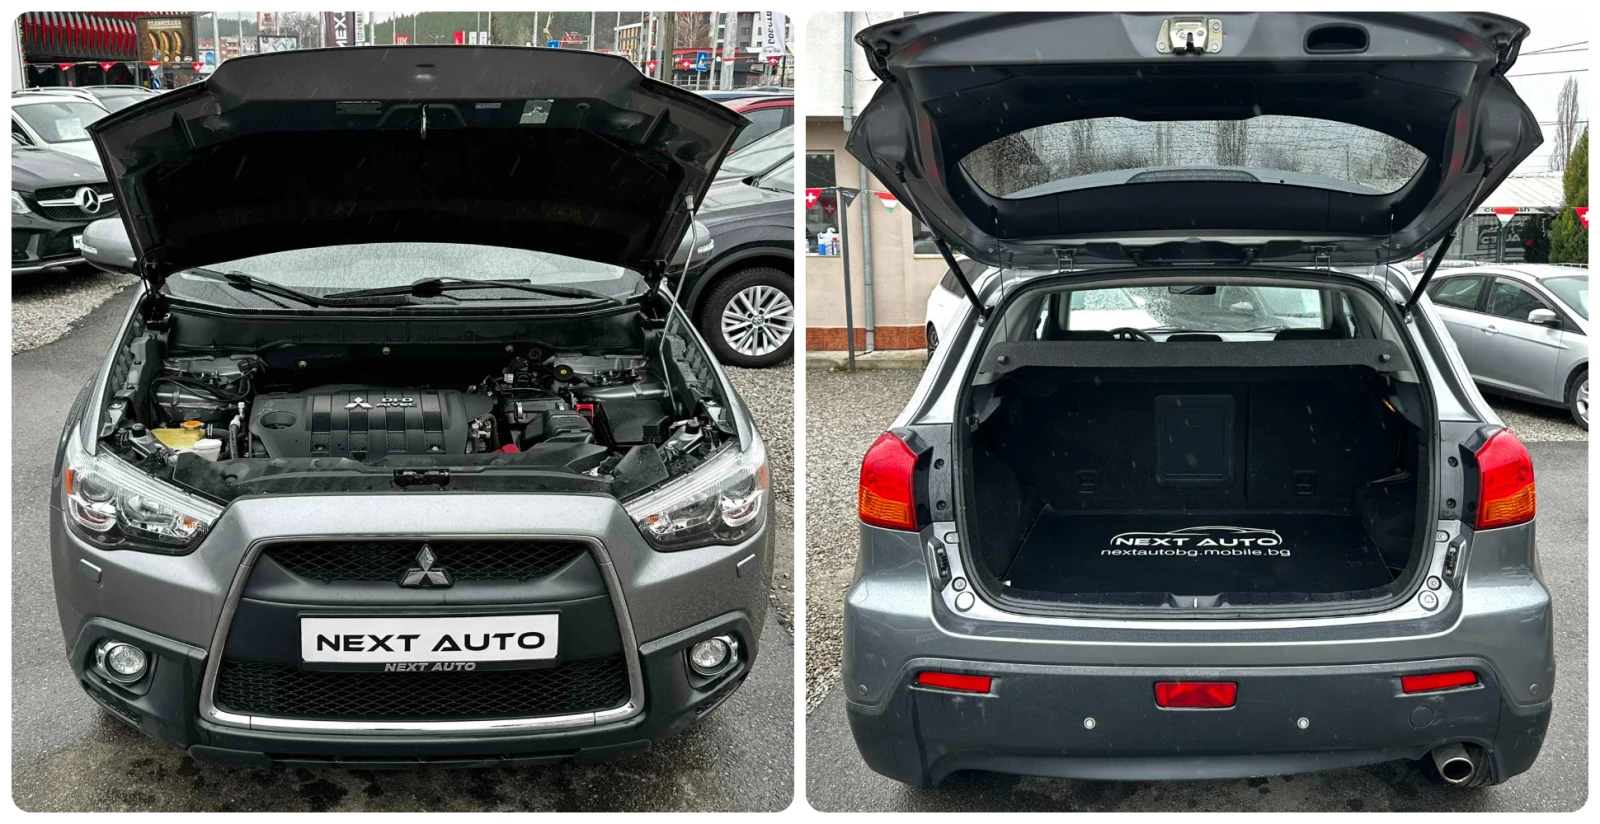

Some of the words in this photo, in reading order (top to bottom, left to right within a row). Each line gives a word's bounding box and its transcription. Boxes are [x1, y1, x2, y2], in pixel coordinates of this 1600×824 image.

[1115, 537, 1190, 546] NEXT
[1196, 537, 1279, 547] AUTO
[1100, 548, 1291, 558] nextautobg.mobile.bg
[316, 634, 421, 652] NEXT
[431, 631, 546, 652] AUTO
[384, 662, 429, 672] NEXT
[430, 662, 476, 671] AUTO
